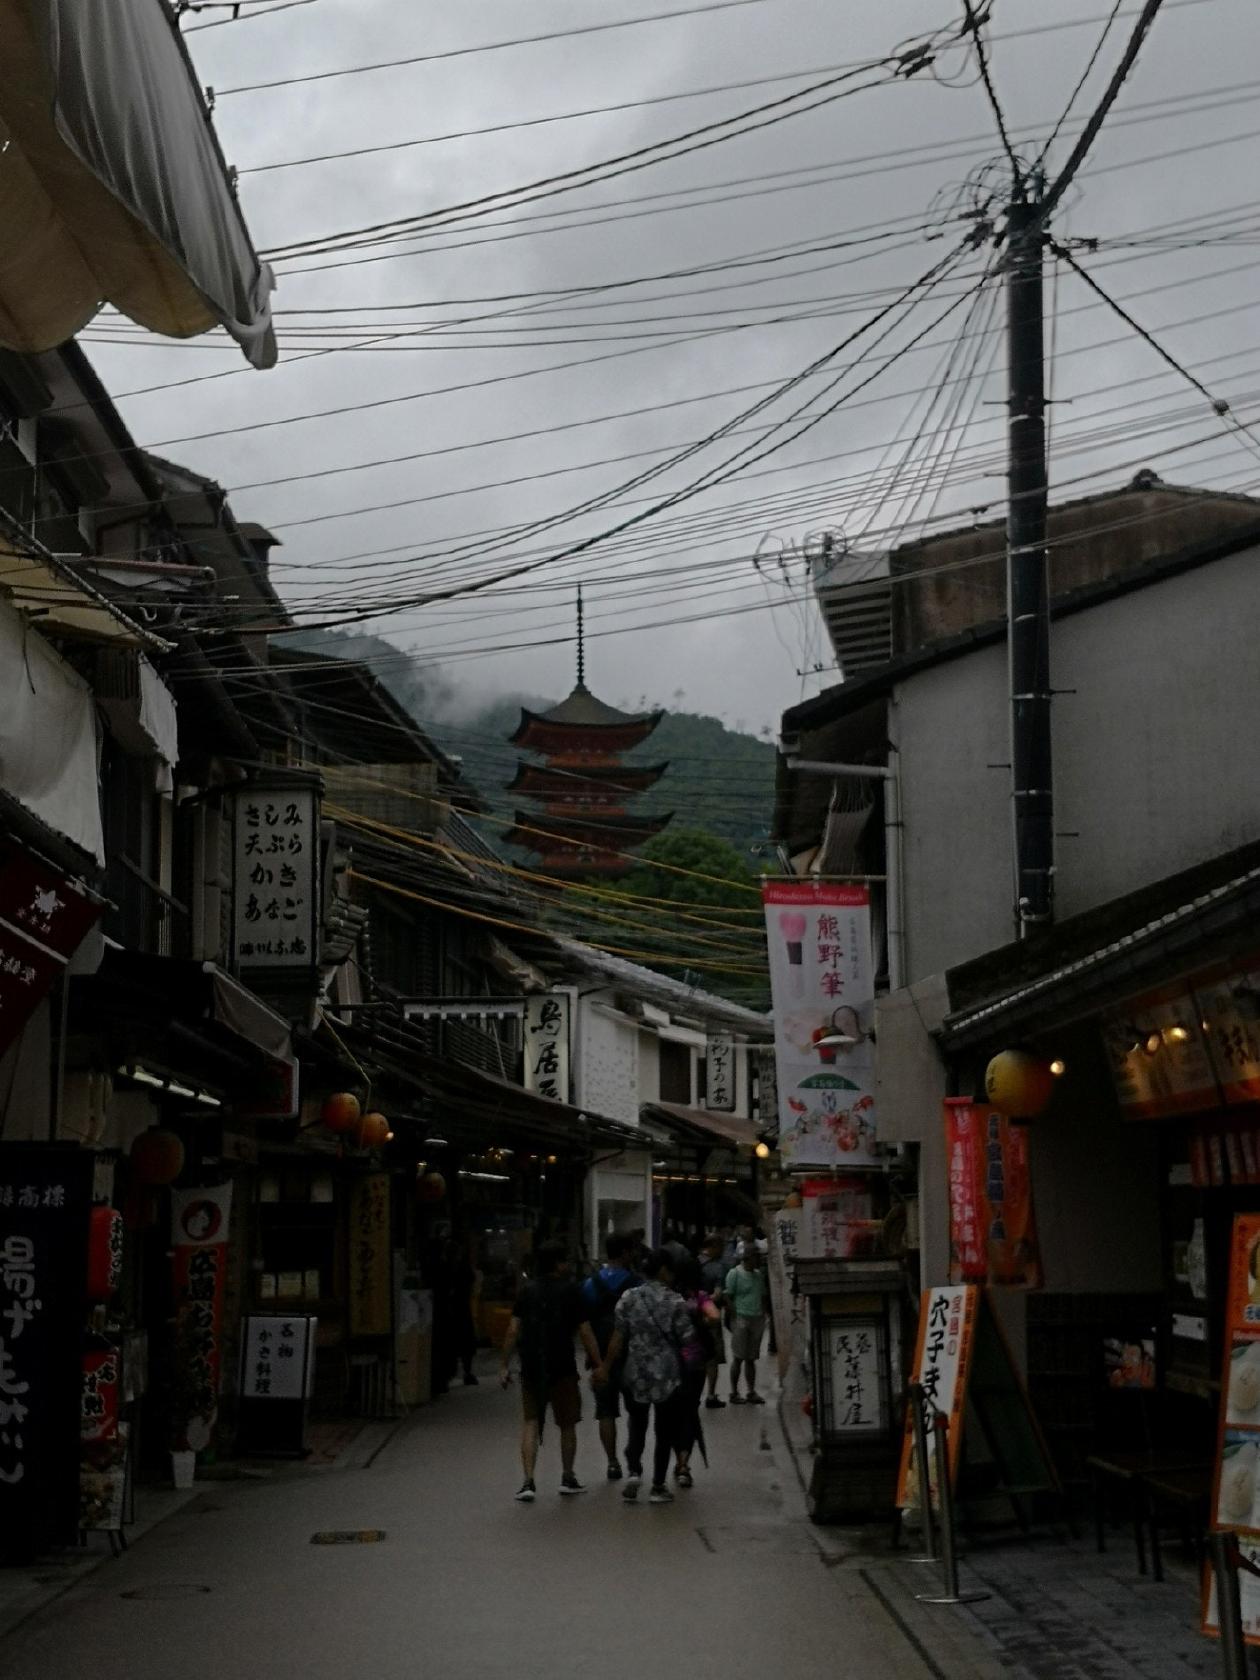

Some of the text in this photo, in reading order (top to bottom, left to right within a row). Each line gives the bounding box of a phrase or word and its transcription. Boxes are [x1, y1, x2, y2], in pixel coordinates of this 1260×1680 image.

[245, 804, 302, 827] さしみ
[245, 833, 302, 856] 天ぷら
[250, 862, 296, 887] かき
[245, 893, 303, 921] あなご
[816, 913, 845, 998] 熊野筆
